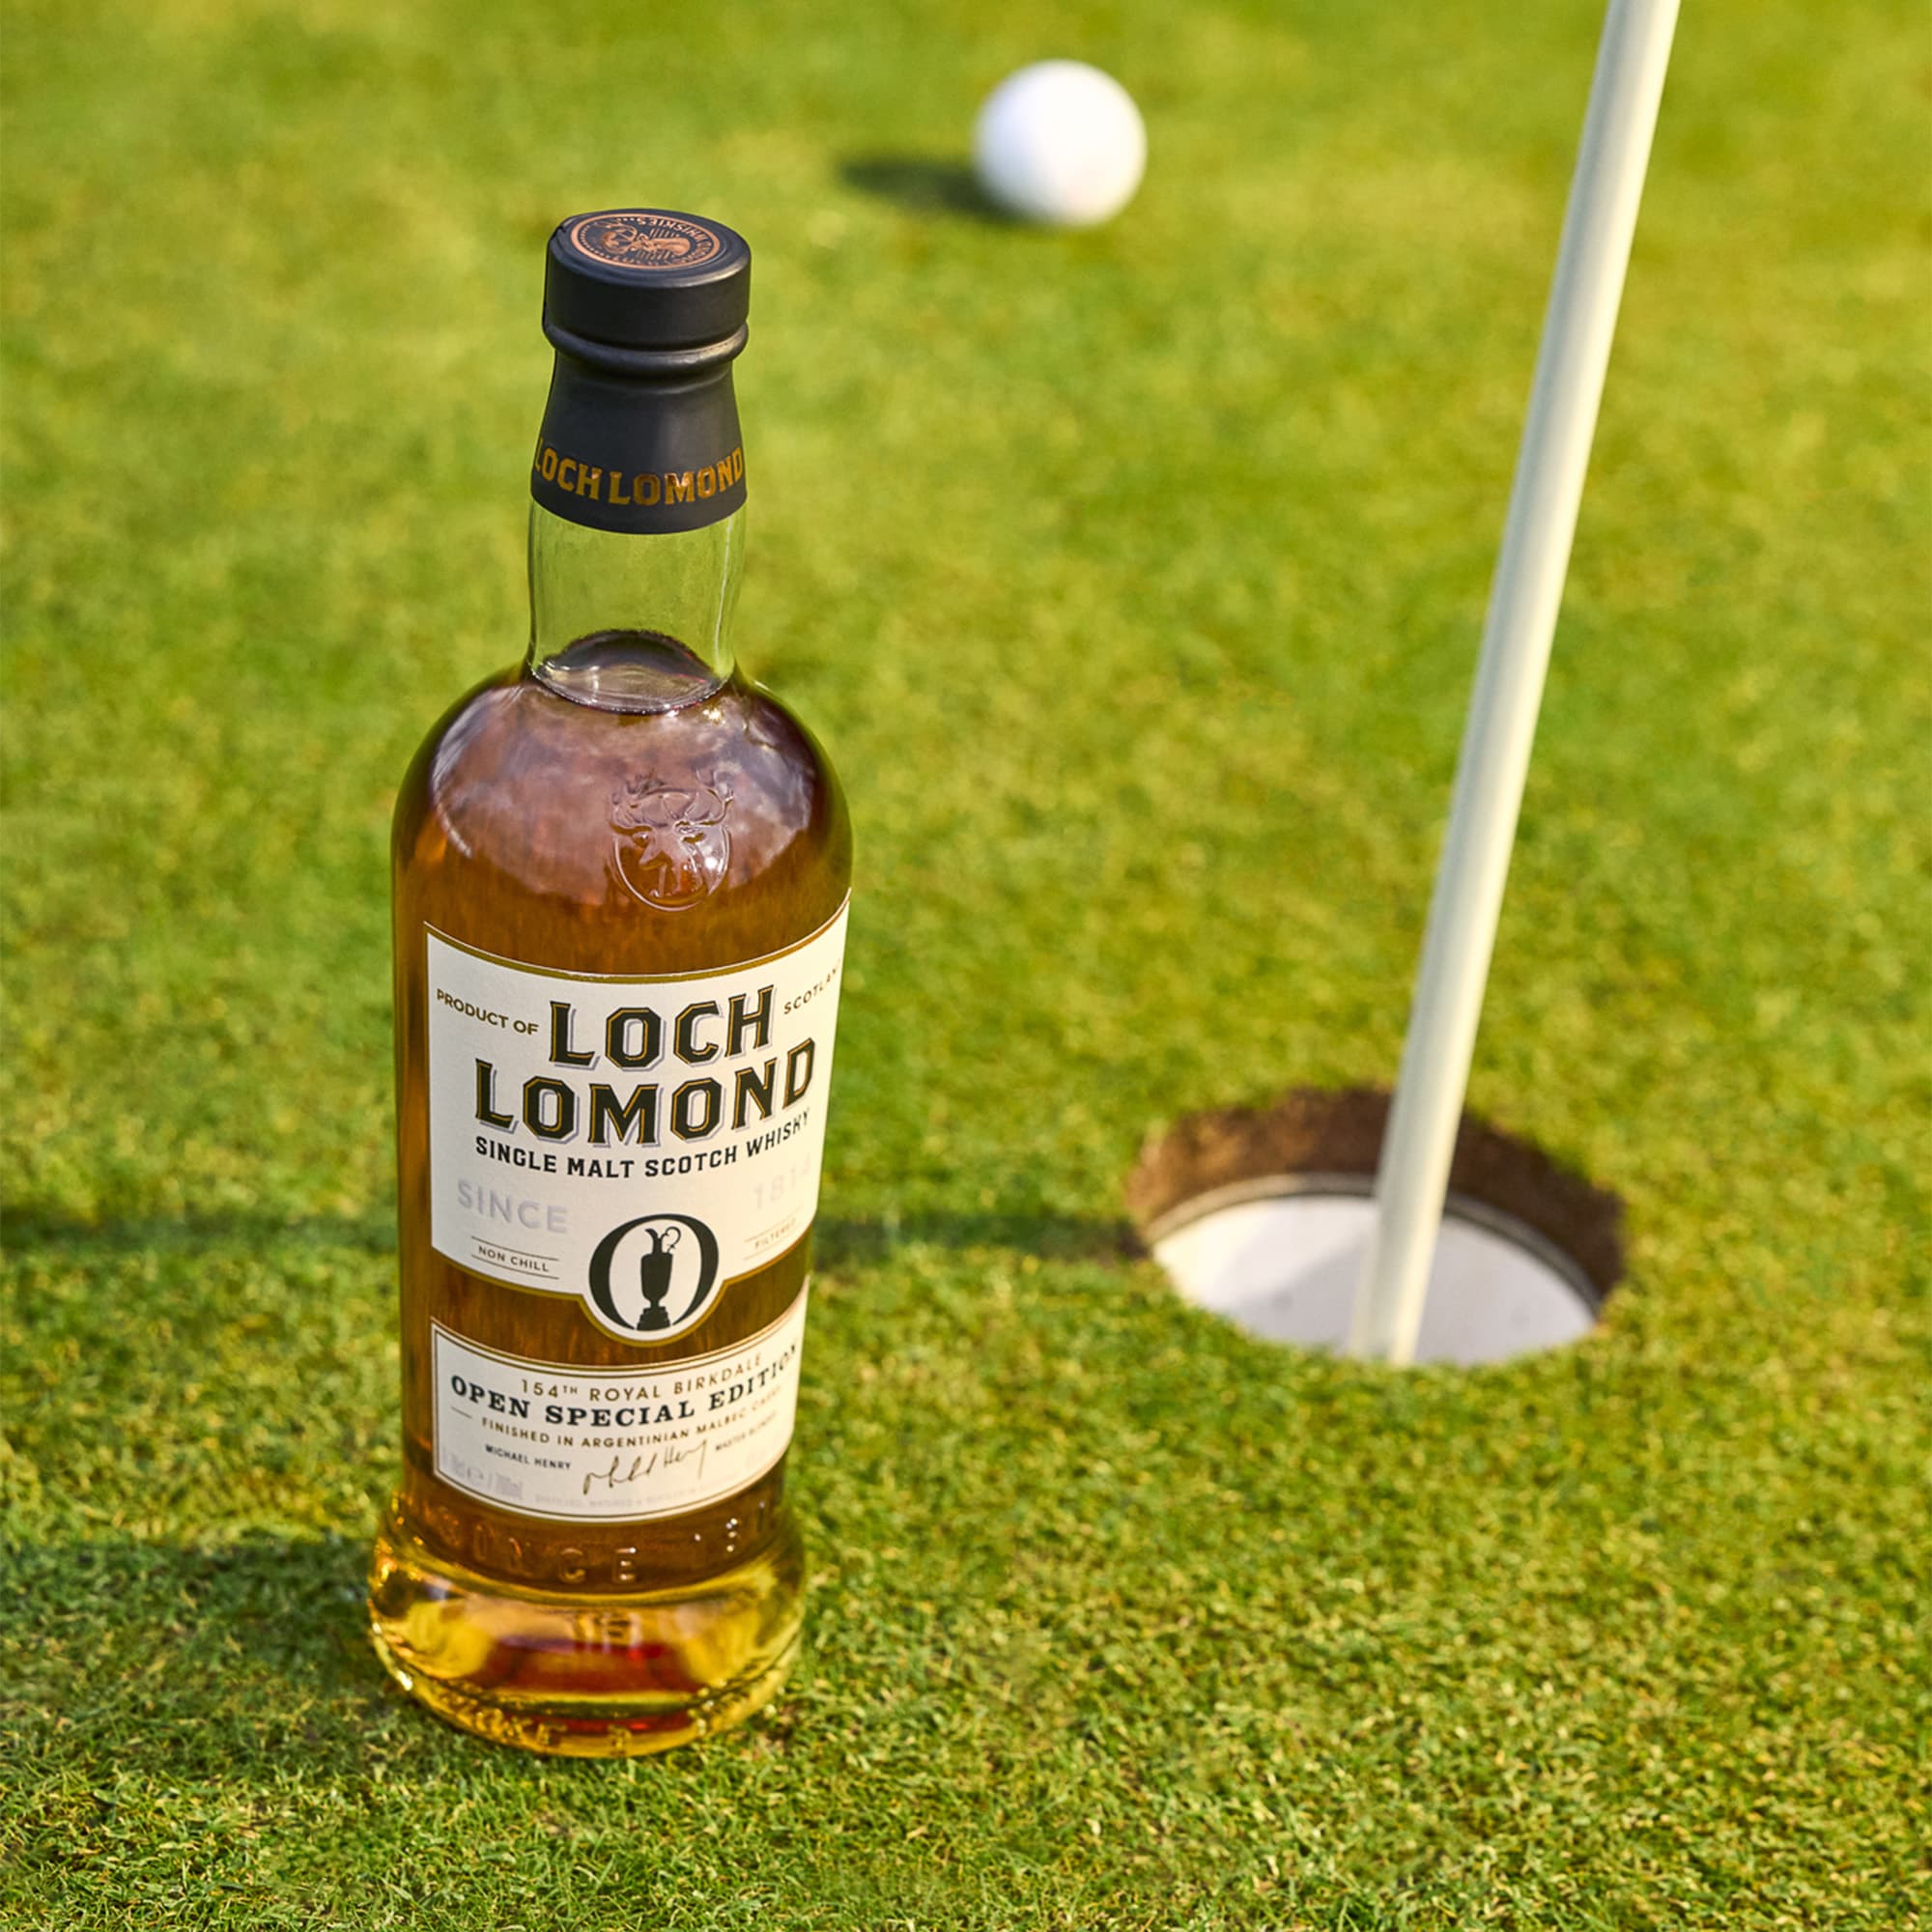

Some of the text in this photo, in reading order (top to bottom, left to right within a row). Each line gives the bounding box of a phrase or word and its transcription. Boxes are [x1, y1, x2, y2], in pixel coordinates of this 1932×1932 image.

[609, 446, 743, 506] LOMOND
[436, 988, 539, 1036] PRODUCT OF
[548, 983, 778, 1069] LOCH
[474, 1037, 816, 1149] LOMOND
[475, 1108, 810, 1179] SINGLE MALT SCOTCH WHISKY
[457, 1179, 568, 1234] SINCE
[478, 1244, 550, 1273] NON CHILL
[451, 1375, 530, 1419] OPEN
[545, 1400, 696, 1428] SPECIAL
[588, 1384, 661, 1402] ROYAL
[673, 1351, 761, 1395] BIRKDALE
[481, 1416, 550, 1444] FINISHED
[556, 1435, 574, 1447] IN
[581, 1429, 690, 1448] ARGENTINIAN
[485, 1443, 572, 1470] MICHAEL HENRY
